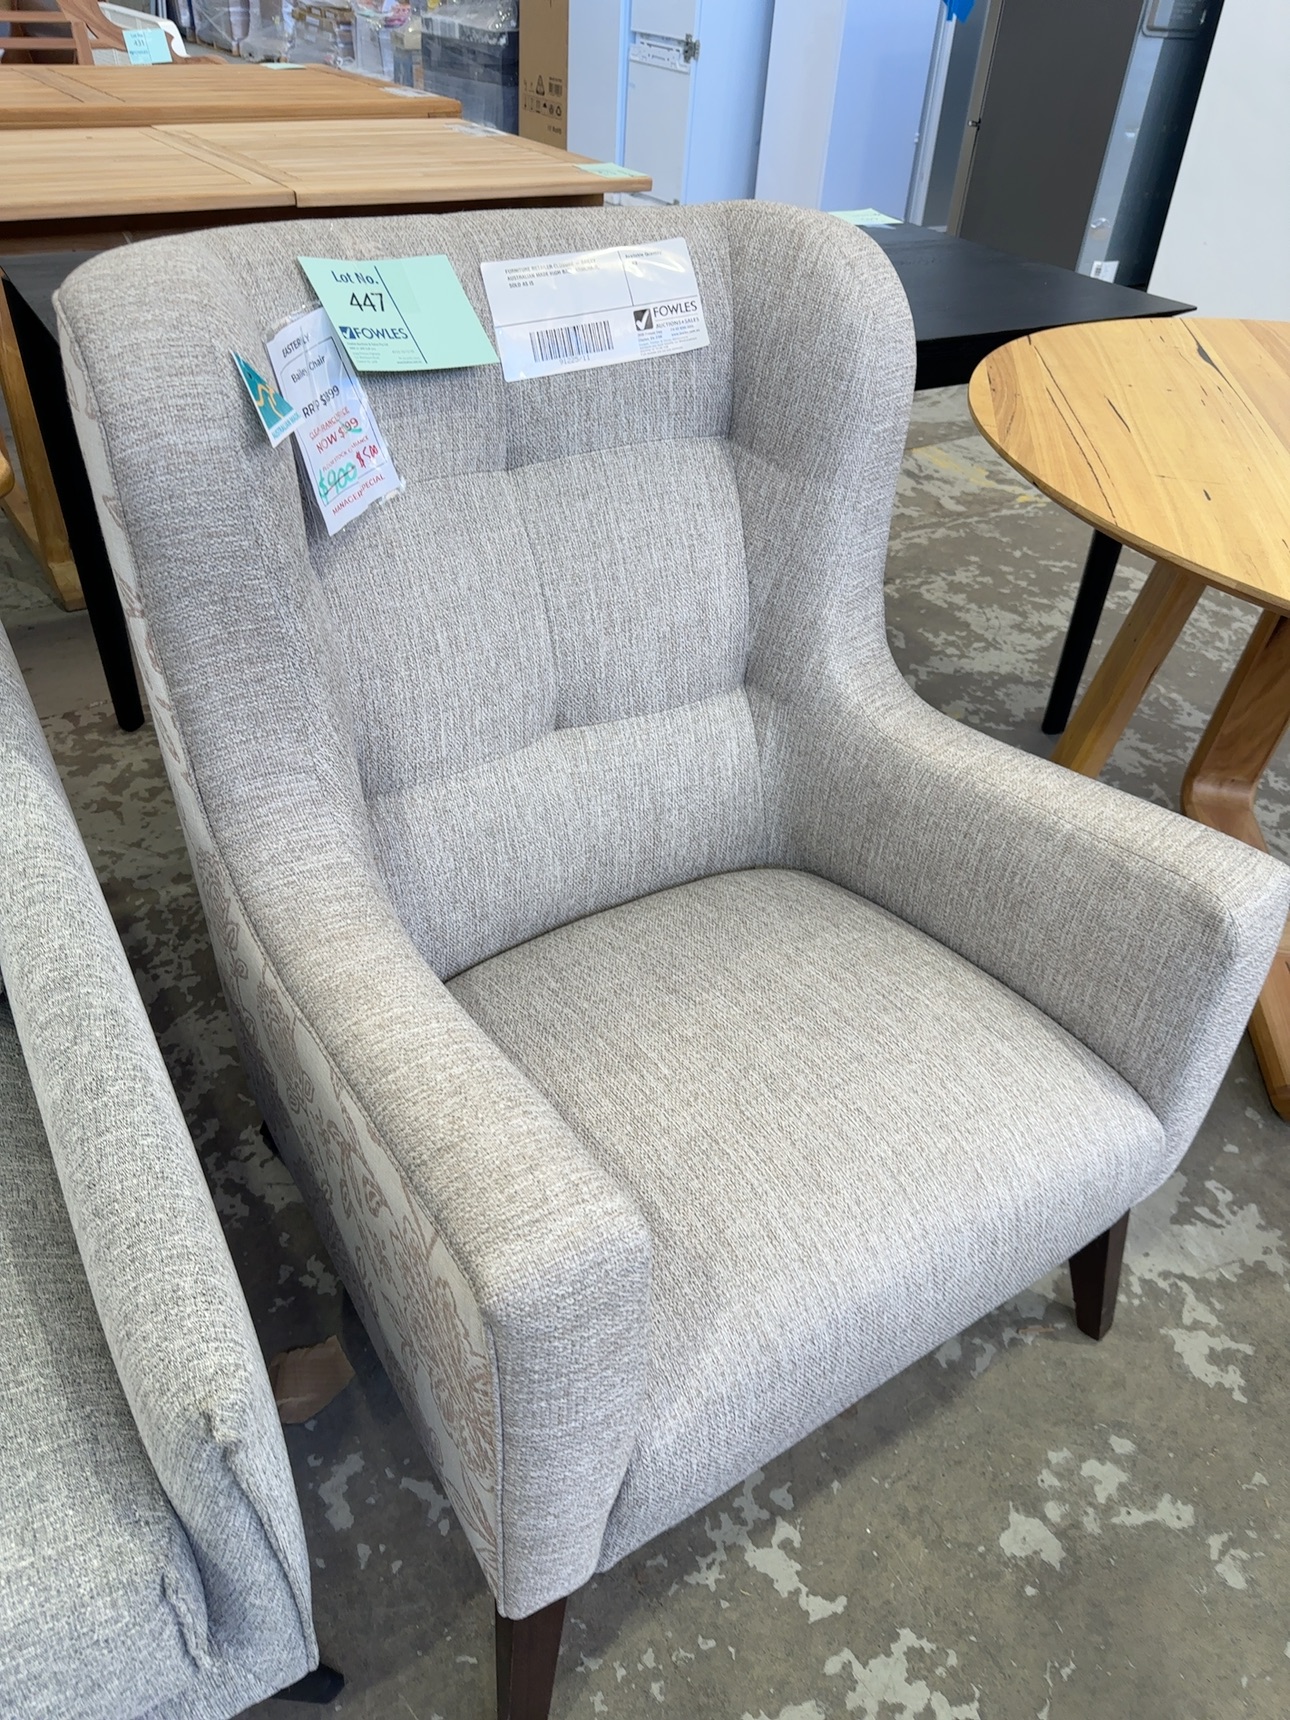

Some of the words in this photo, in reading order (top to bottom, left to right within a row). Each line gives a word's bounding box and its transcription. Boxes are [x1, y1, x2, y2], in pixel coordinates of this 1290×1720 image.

[331, 270, 354, 284] Lot
[359, 272, 379, 285] No.
[350, 292, 385, 312] 447
[653, 300, 698, 318] FOWLES
[354, 327, 409, 340] FOWLES
[309, 355, 326, 371] Chair
[302, 400, 320, 418] RRP
[316, 432, 338, 454] NOW
